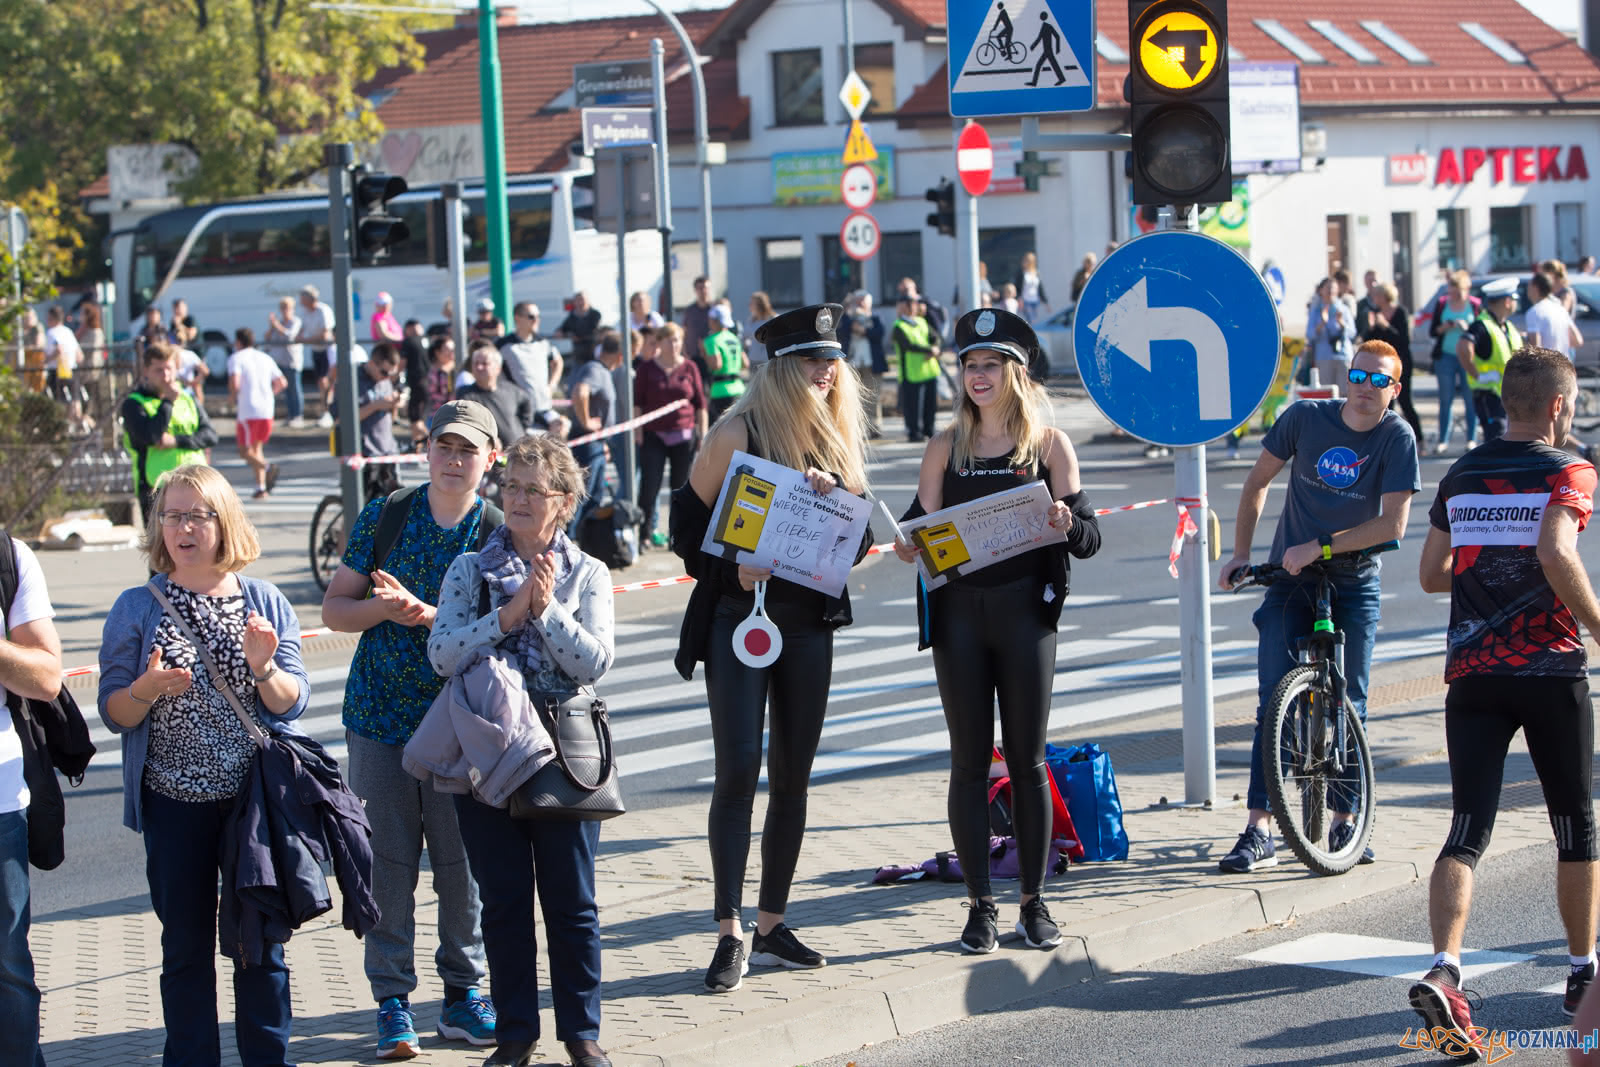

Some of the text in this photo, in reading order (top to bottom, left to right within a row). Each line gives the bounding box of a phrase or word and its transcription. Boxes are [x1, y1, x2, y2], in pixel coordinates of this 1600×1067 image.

[1433, 145, 1590, 187] APTEKA
[848, 224, 876, 246] 40
[1321, 458, 1356, 478] NASA
[788, 492, 854, 523] To nie fotoradar
[839, 502, 854, 514] się!
[977, 511, 992, 519] nie
[992, 498, 1036, 514] fotoradar
[1450, 507, 1541, 524] BRIDGESTONE
[776, 520, 823, 542] CIEBIE
[1462, 524, 1492, 534] Journey,
[1493, 525, 1506, 533] Our
[1507, 525, 1533, 533] Passion
